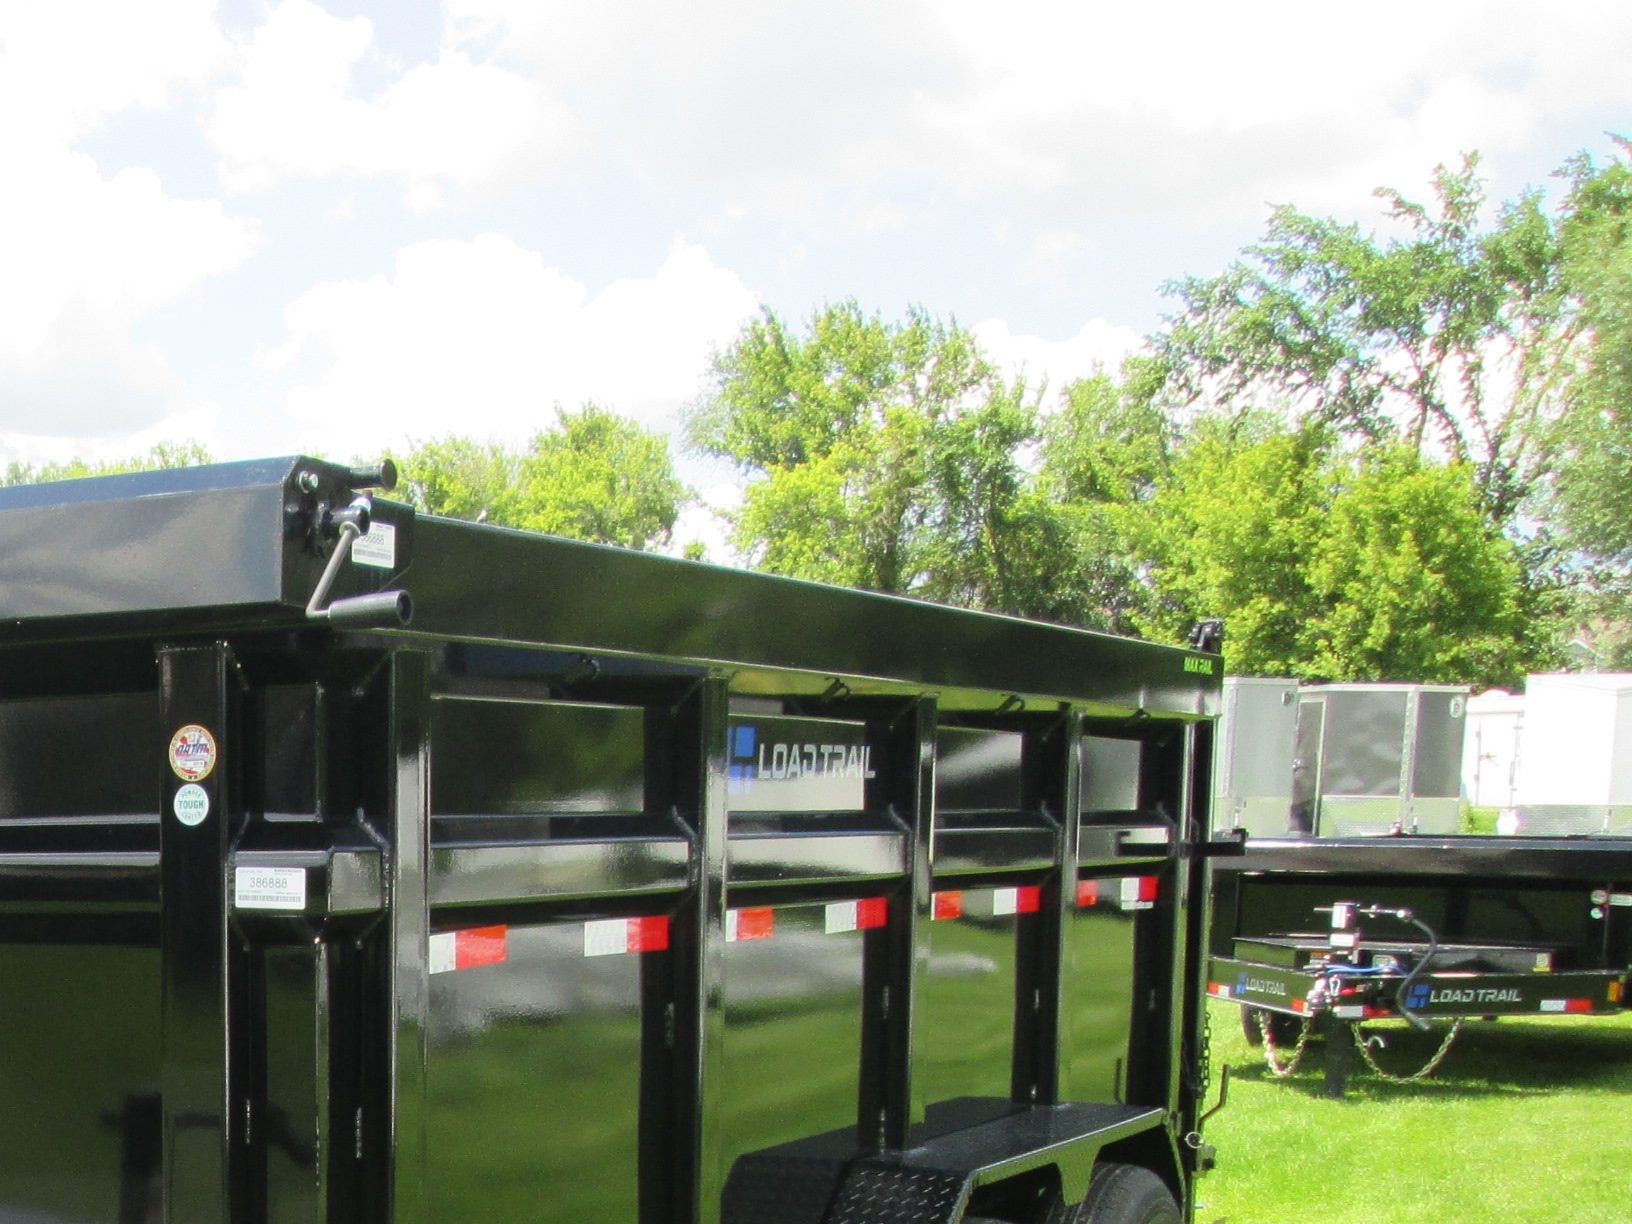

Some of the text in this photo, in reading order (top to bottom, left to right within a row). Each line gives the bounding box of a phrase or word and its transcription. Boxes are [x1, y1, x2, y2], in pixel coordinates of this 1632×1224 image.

[758, 743, 876, 779] LOAD TRAIL
[178, 800, 204, 809] TOUGH
[249, 877, 288, 889] 386888
[1430, 989, 1522, 1003] LOAD TRAIL
